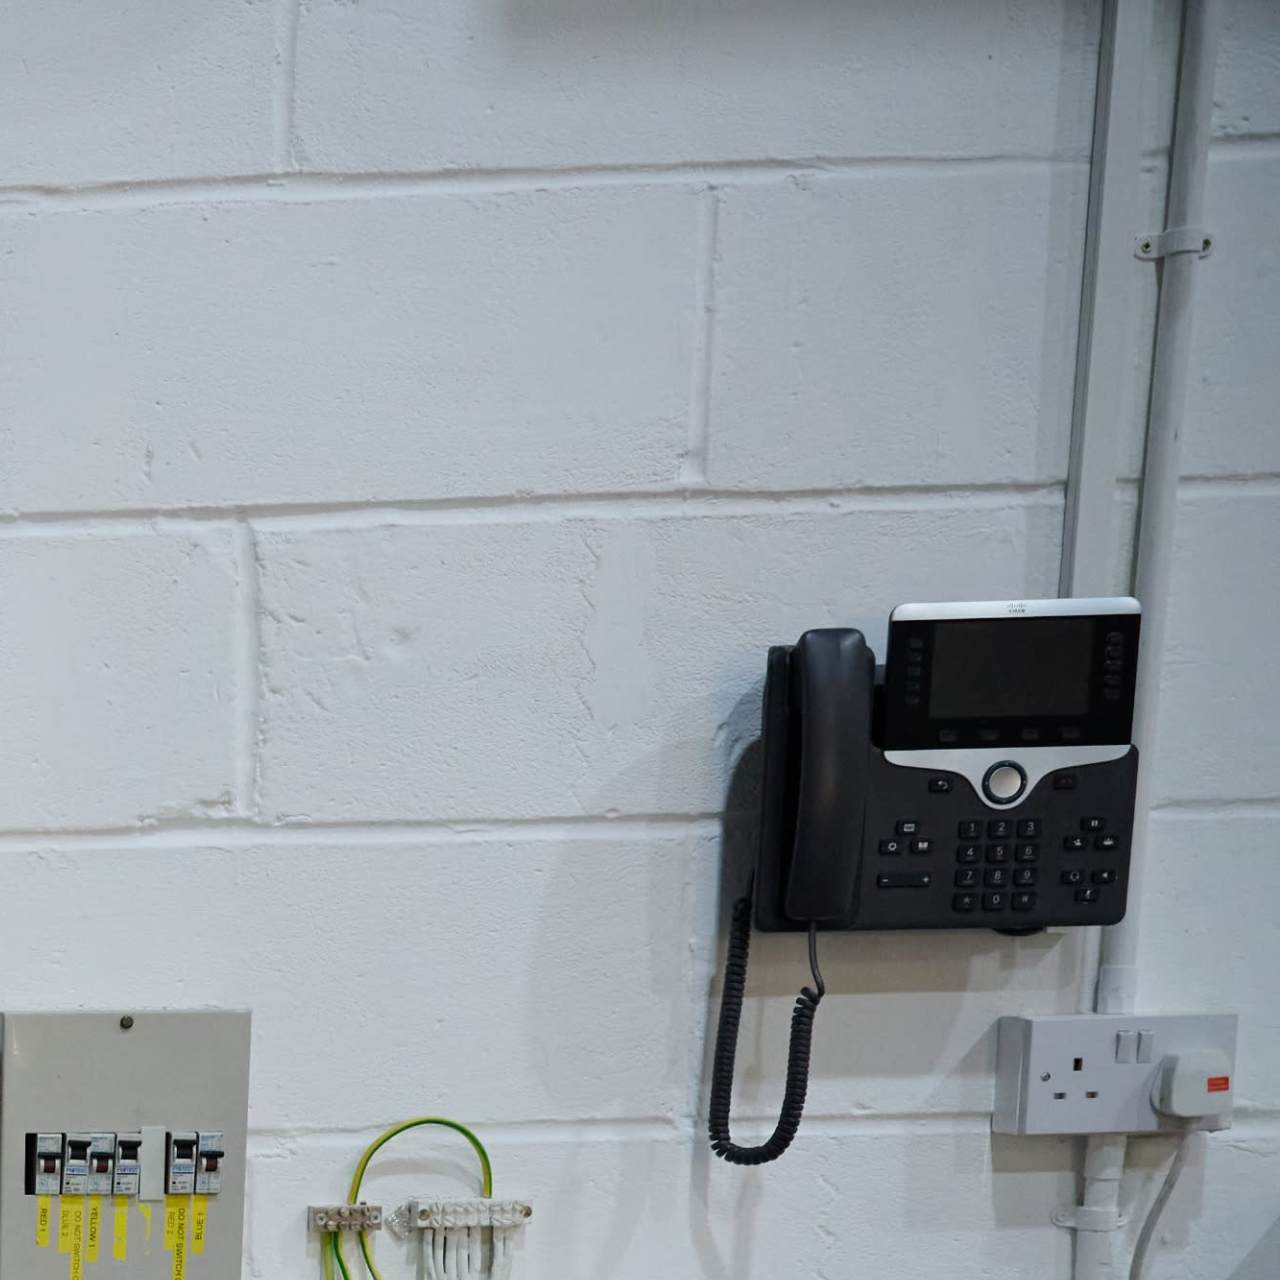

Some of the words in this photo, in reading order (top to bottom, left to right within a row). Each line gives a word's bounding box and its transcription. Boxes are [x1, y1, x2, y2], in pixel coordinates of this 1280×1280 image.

[40, 1208, 48, 1226] RED
[74, 1210, 82, 1223] DO
[167, 1211, 176, 1228] RED
[178, 1207, 186, 1221] DO
[89, 1207, 98, 1242] YELLOW
[177, 1222, 185, 1240] NOT
[194, 1217, 204, 1240] BLUE
[176, 1242, 184, 1276] SWITCH
